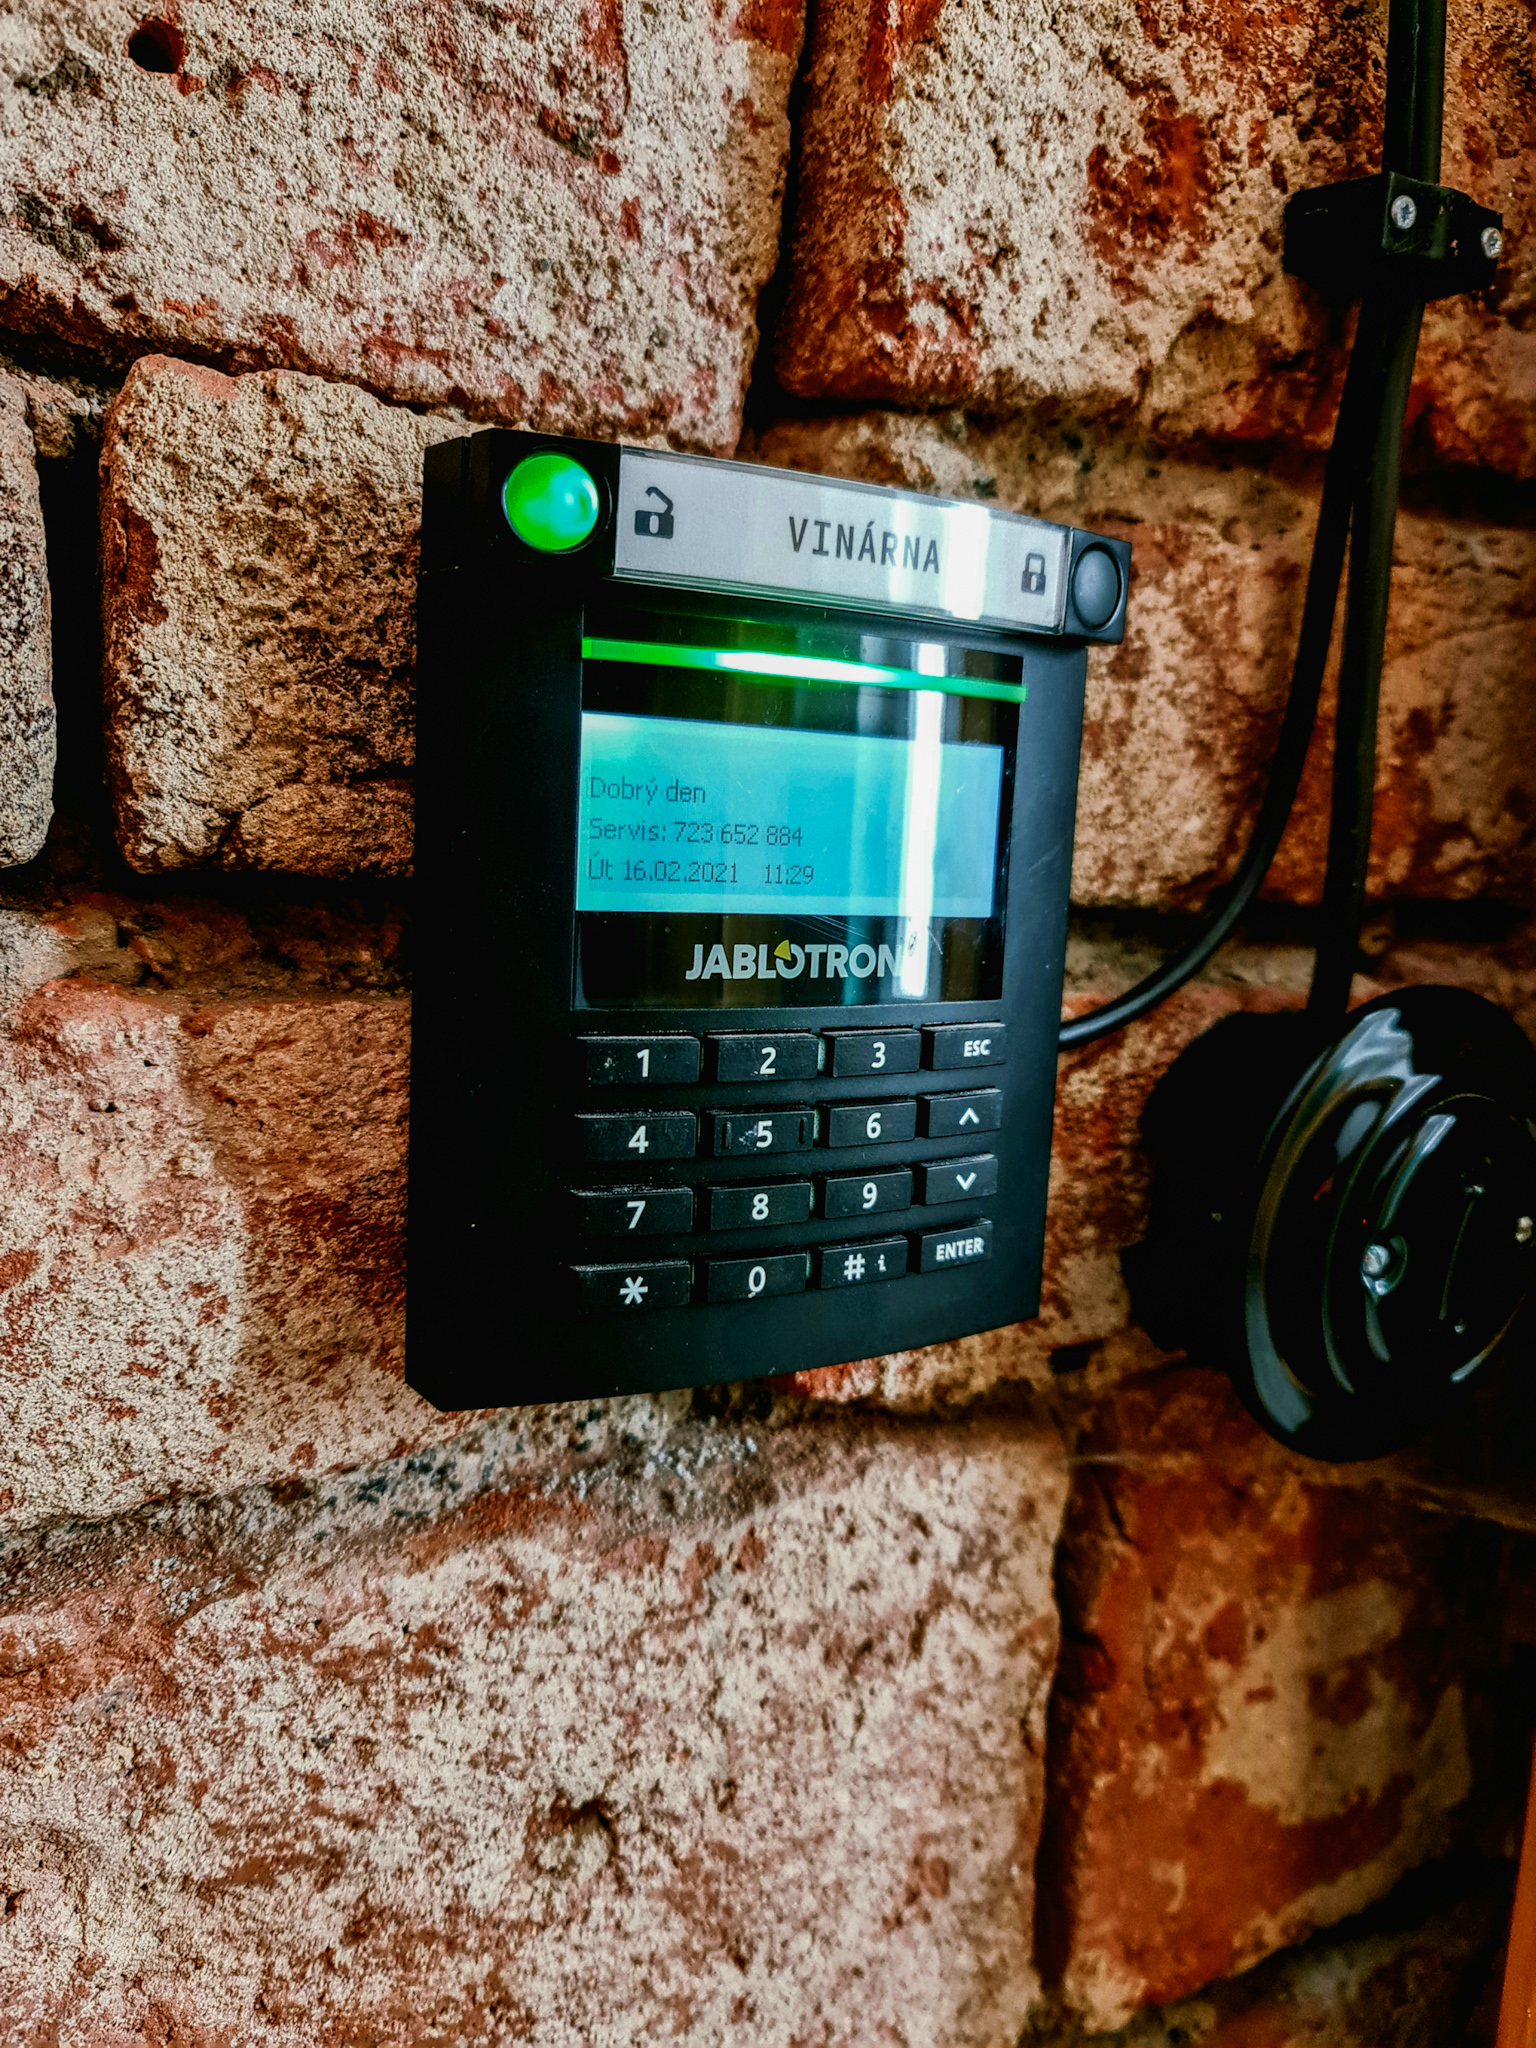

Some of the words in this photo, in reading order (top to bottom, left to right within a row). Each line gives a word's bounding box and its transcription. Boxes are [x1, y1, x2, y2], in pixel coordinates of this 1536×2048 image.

[788, 514, 941, 575] VINÁRNA
[590, 775, 658, 806] Dobrý
[666, 778, 706, 803] den
[589, 817, 666, 842] Servis:
[674, 821, 714, 844] 723
[720, 823, 759, 845] 652
[766, 825, 803, 846] 884
[589, 851, 613, 880] Út
[623, 860, 738, 883] 16.02.2021
[764, 864, 814, 885] 11:29
[684, 939, 902, 981] JABLOTRON
[759, 1046, 777, 1075] 2
[871, 1041, 886, 1068] 3
[963, 1038, 991, 1058] ESC
[636, 1048, 651, 1078] 1
[627, 1125, 650, 1154] 4
[756, 1120, 774, 1148] 5
[865, 1112, 882, 1139] 6
[751, 1193, 770, 1221] 8
[862, 1181, 878, 1209] 9
[626, 1200, 646, 1229] 7
[935, 1237, 985, 1261] ENTER
